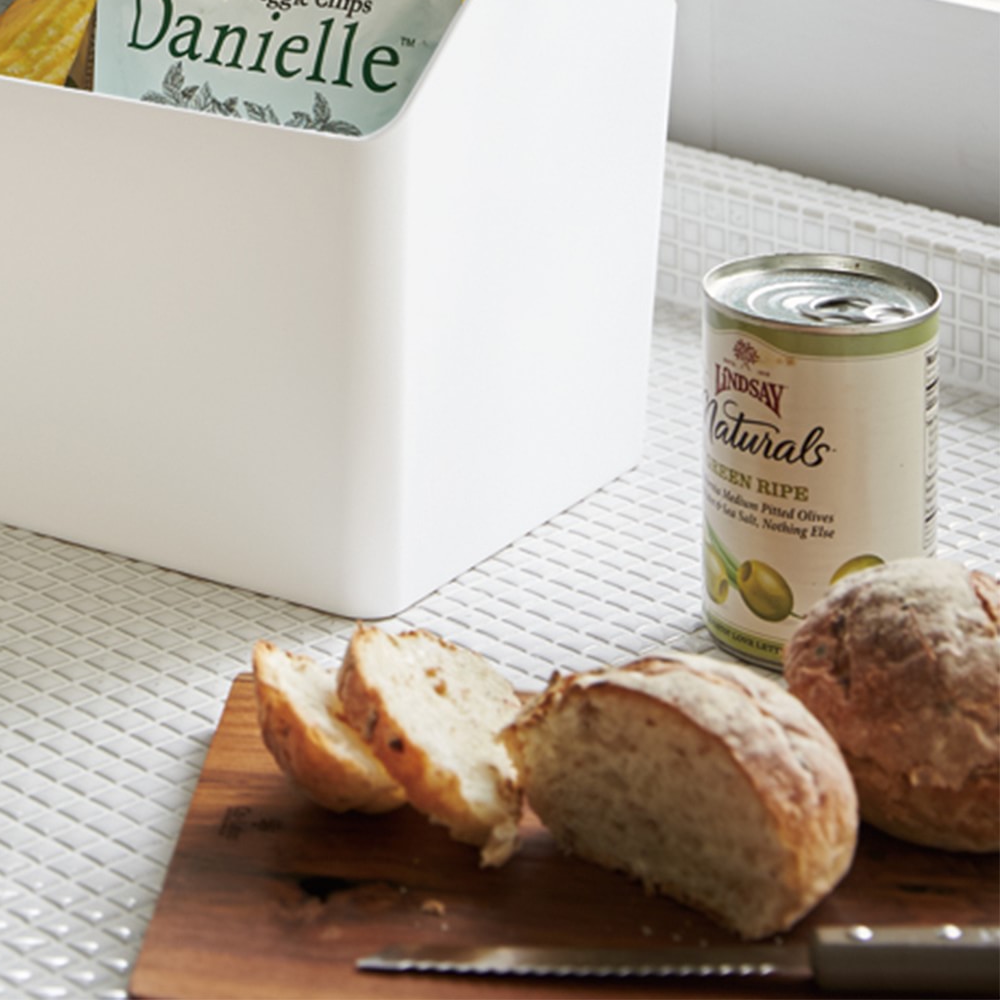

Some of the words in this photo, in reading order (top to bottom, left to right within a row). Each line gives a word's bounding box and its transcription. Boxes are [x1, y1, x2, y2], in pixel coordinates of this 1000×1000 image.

[757, 478, 809, 502] RIPE
[722, 488, 759, 511] Medium
[761, 502, 796, 520] Pitted
[797, 508, 835, 523] Olives
[762, 518, 808, 540] Nothing
[810, 525, 836, 539] Else
